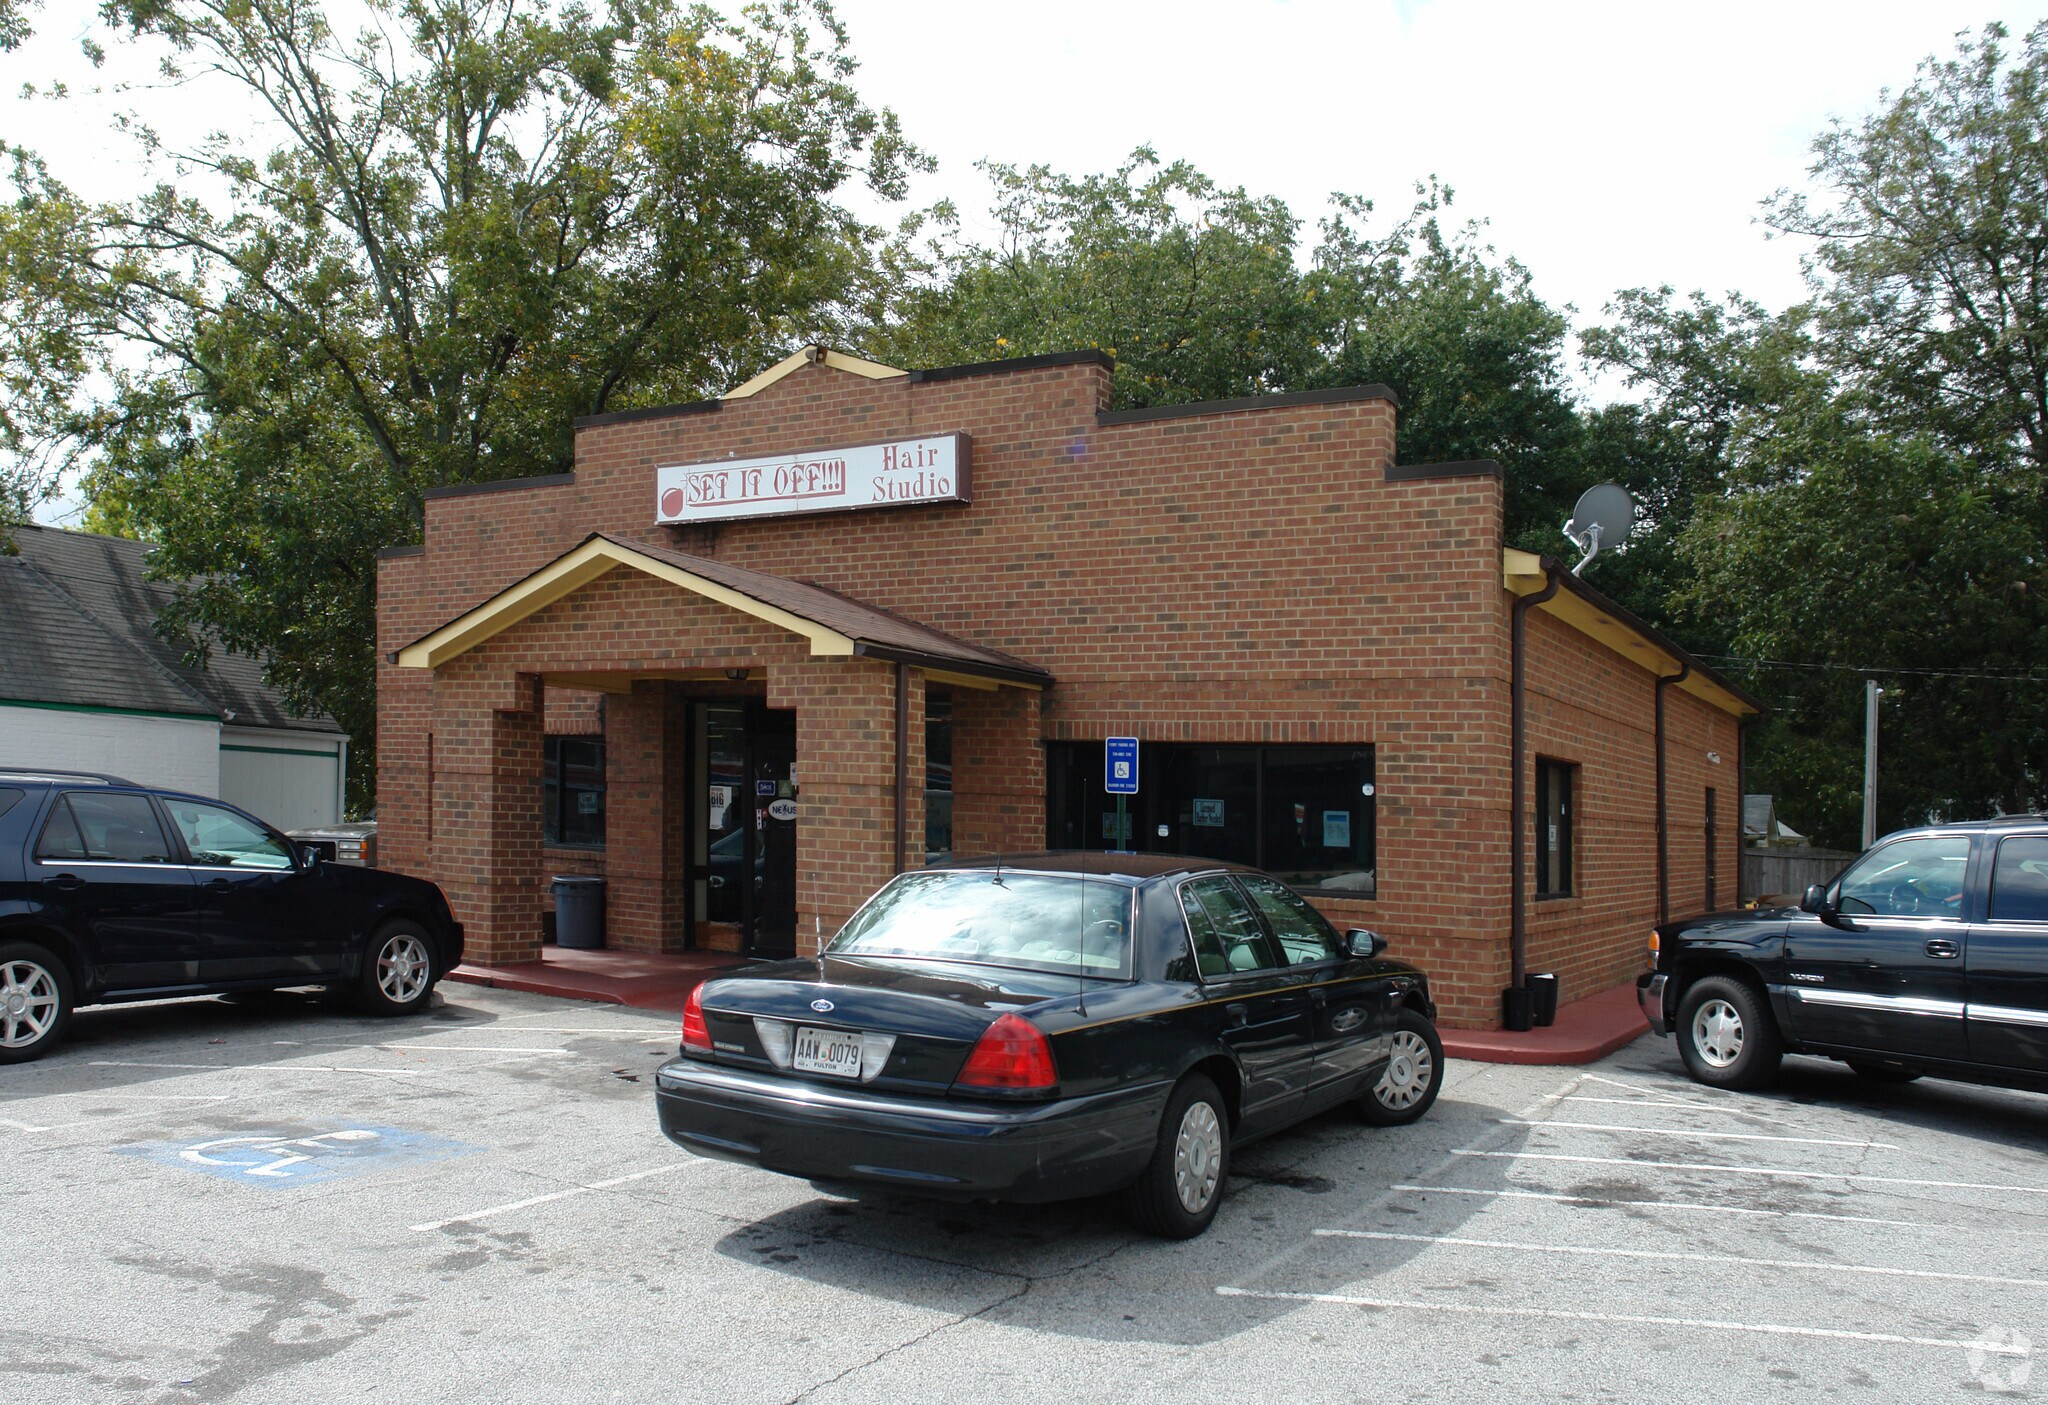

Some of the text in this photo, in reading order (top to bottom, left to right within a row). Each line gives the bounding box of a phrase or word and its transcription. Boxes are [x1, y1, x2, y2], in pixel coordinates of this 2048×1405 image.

[882, 443, 939, 472] Hair
[687, 459, 840, 502] SET IT OFF!!!
[872, 471, 951, 502] Studio
[711, 791, 724, 805] BIG
[1790, 973, 1824, 983] YUKON
[829, 1042, 859, 1065] 0079
[813, 1061, 837, 1070] FULTON
